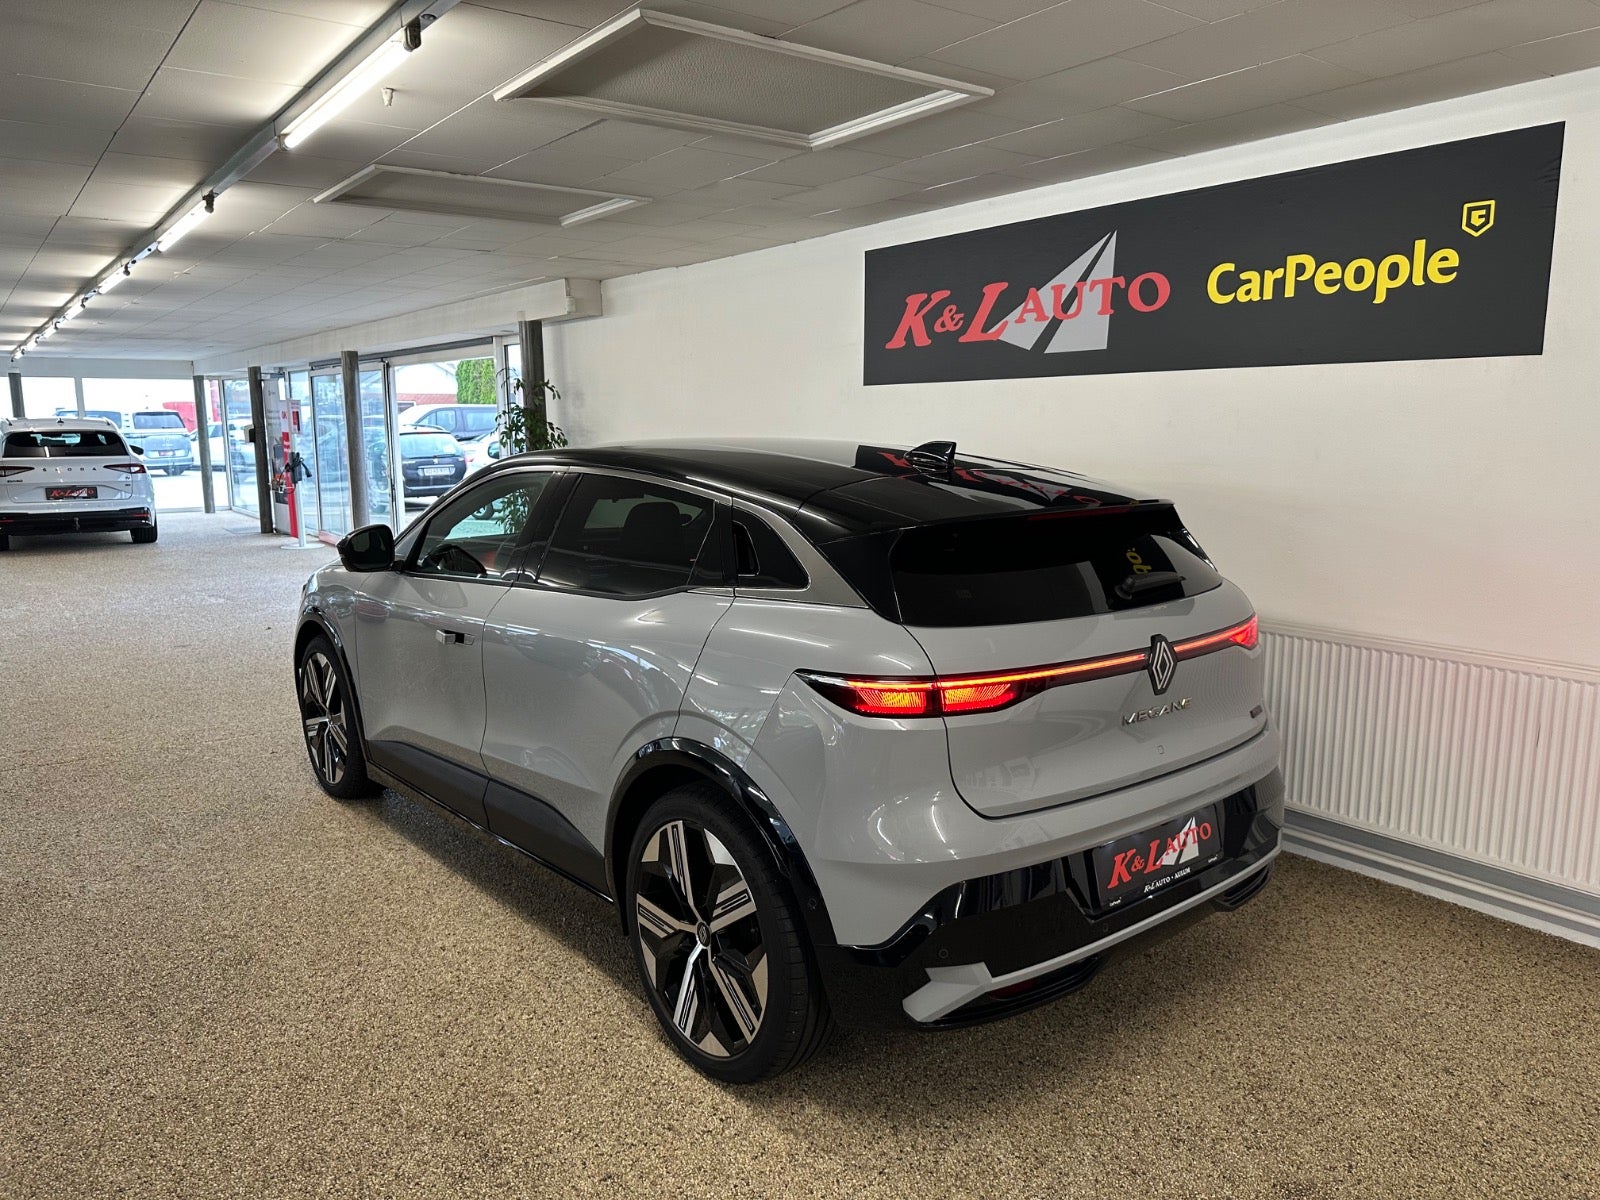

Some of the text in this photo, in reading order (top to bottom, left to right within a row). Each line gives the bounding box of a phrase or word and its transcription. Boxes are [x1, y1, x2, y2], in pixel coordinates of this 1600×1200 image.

[1206, 238, 1460, 305] CarPeople
[885, 271, 1171, 350] K&L AUTO
[1122, 697, 1192, 726] MEGANE
[1107, 822, 1213, 889] K&L AUTO
